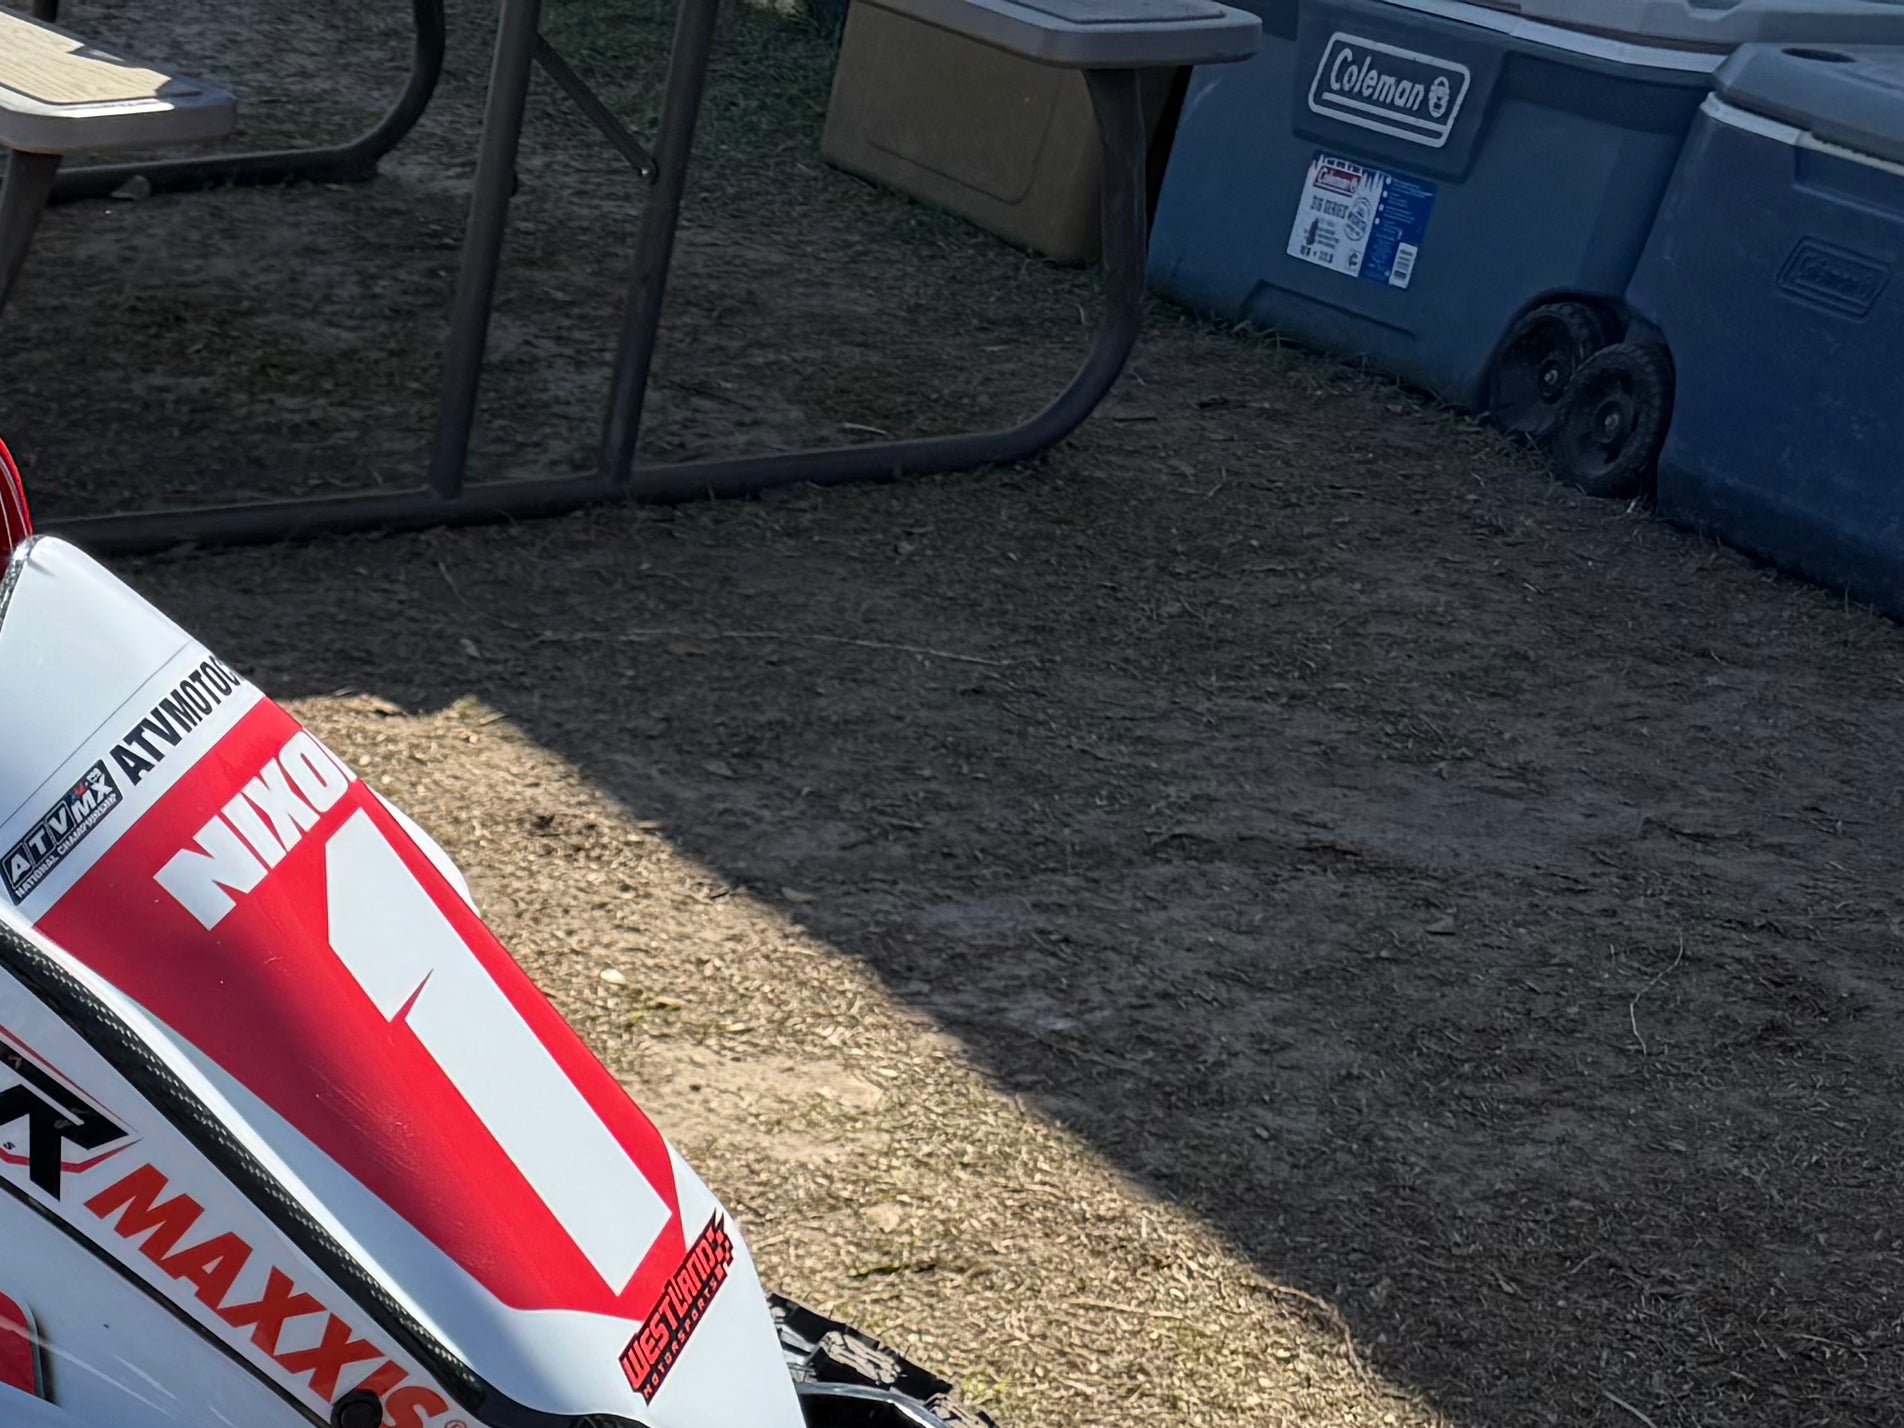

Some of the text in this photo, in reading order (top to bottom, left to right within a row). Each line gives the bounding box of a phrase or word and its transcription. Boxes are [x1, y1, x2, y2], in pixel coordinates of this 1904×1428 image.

[1329, 46, 1425, 114] Coleman
[152, 729, 357, 932] NIXO
[324, 806, 673, 1296] 1
[622, 1238, 717, 1390] WESTLAND
[643, 1277, 718, 1399] MOTORSPORTS
